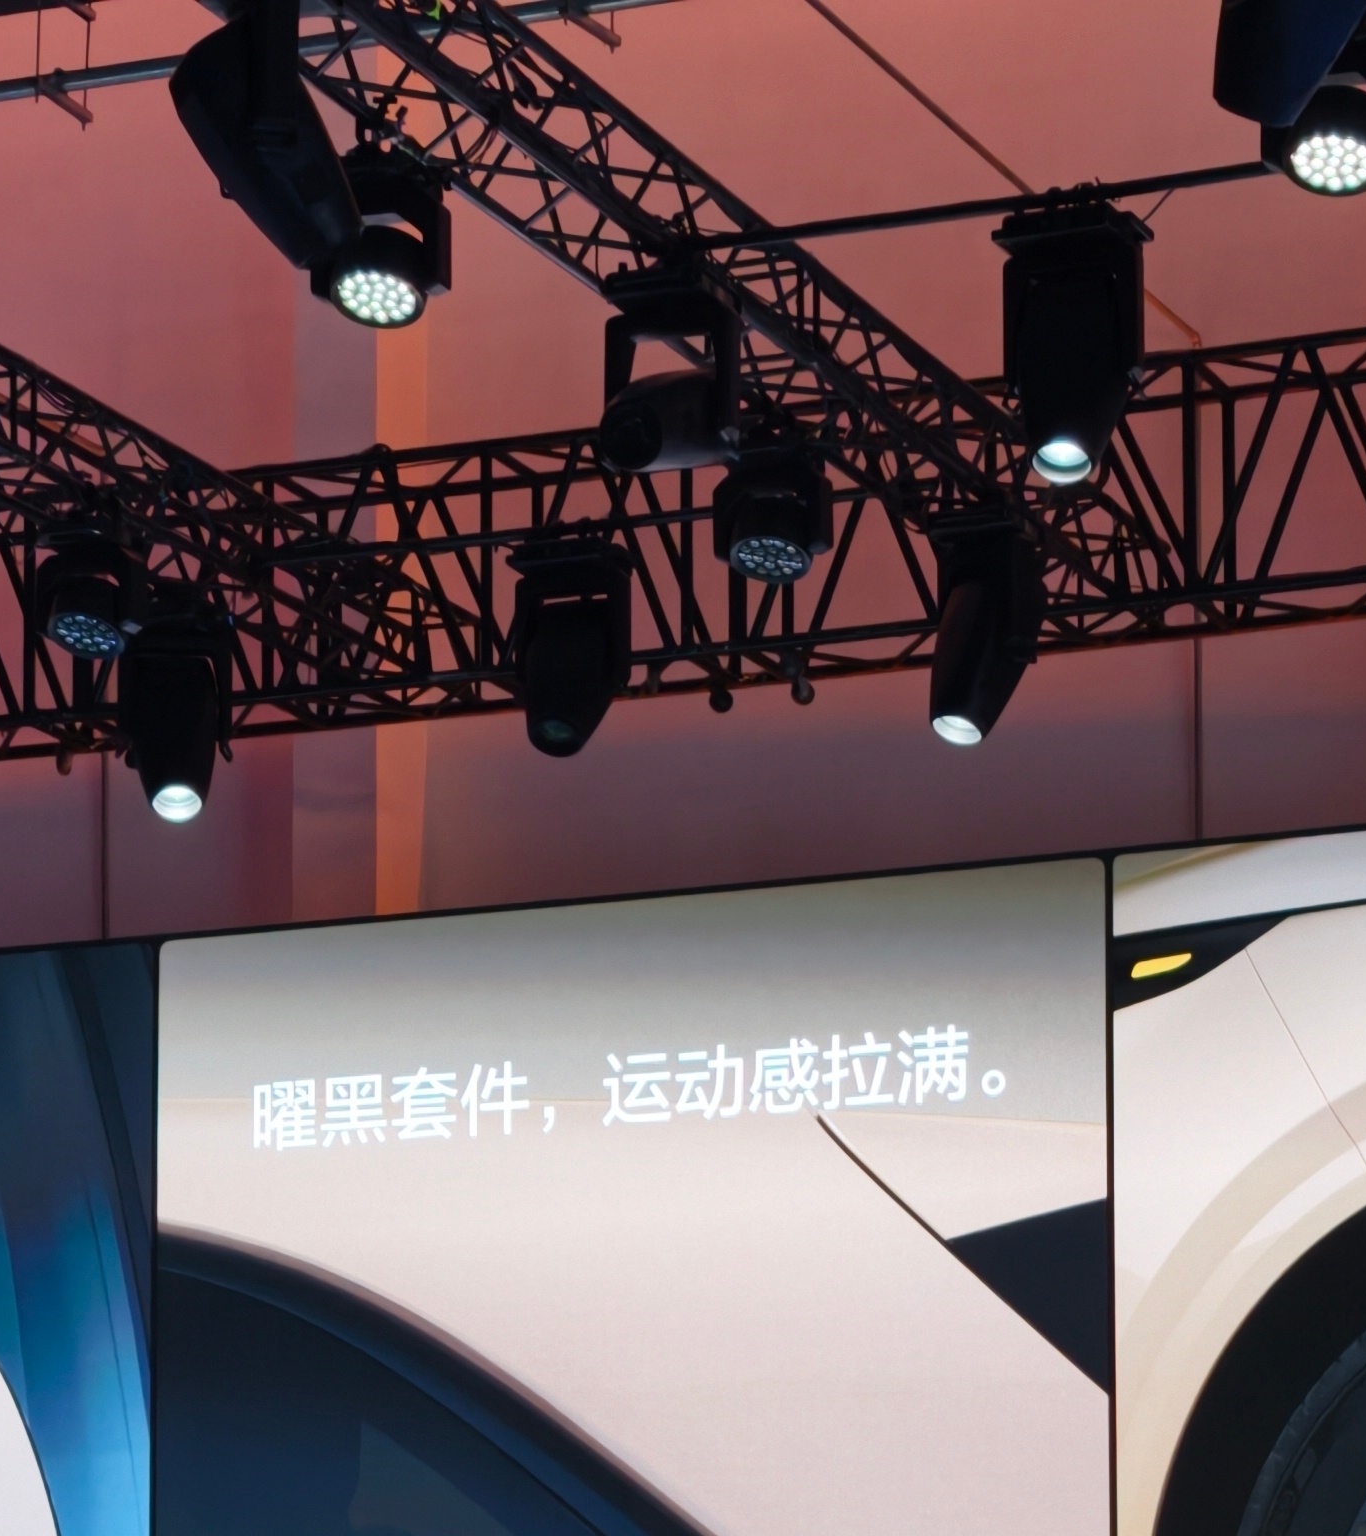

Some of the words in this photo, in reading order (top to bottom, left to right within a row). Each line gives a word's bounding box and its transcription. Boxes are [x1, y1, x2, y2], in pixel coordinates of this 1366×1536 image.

[252, 1024, 1008, 1151] 曜黑套件，运动感拉满。
